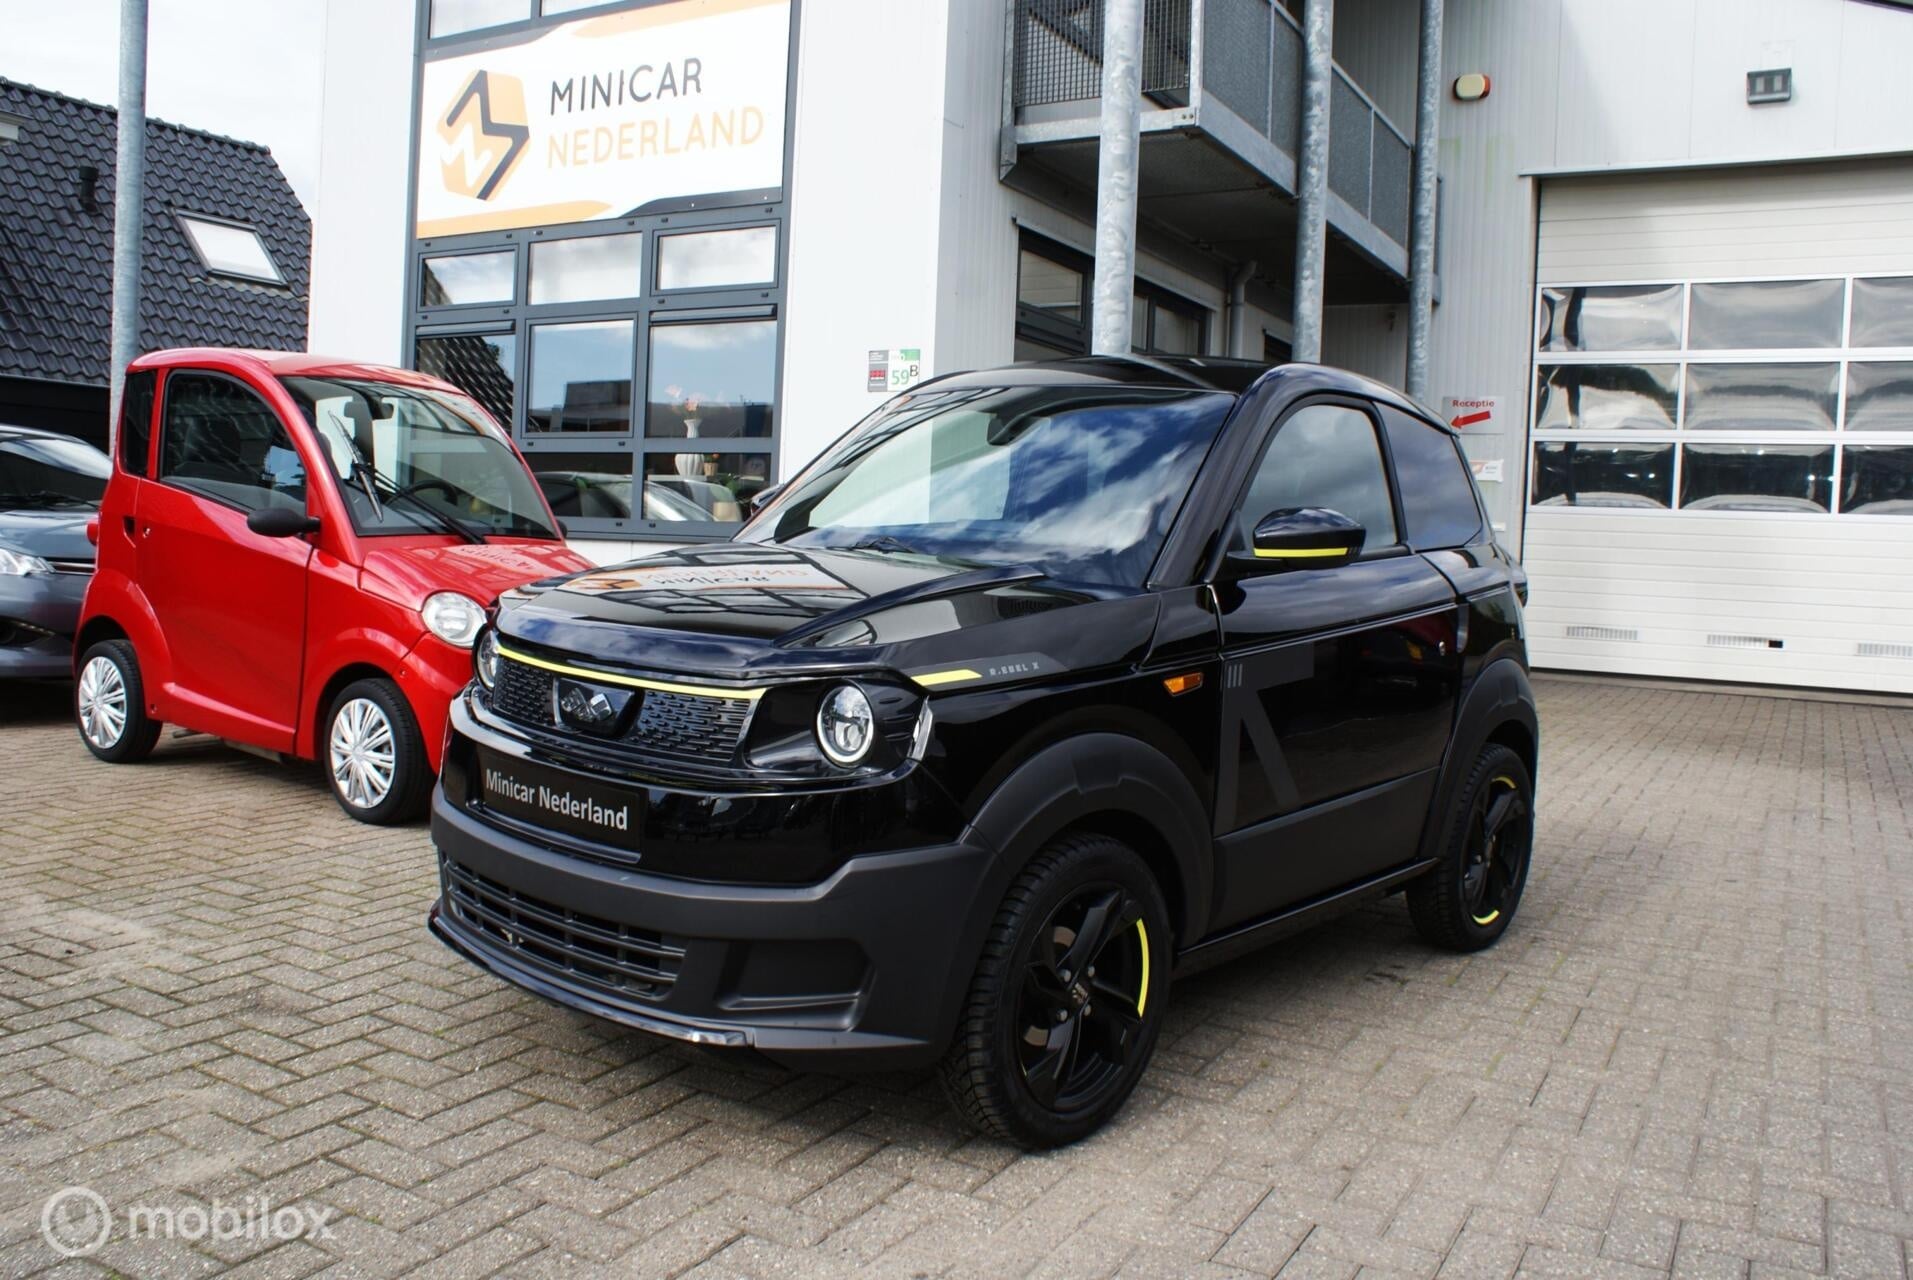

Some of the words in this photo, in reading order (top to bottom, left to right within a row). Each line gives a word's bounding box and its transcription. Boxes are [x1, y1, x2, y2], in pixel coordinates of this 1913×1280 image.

[549, 57, 702, 116] MINICAR
[547, 106, 764, 169] NEDERLAND
[1452, 399, 1495, 408] Receptie
[486, 768, 535, 804] Minicar
[538, 785, 628, 831] Nederland
